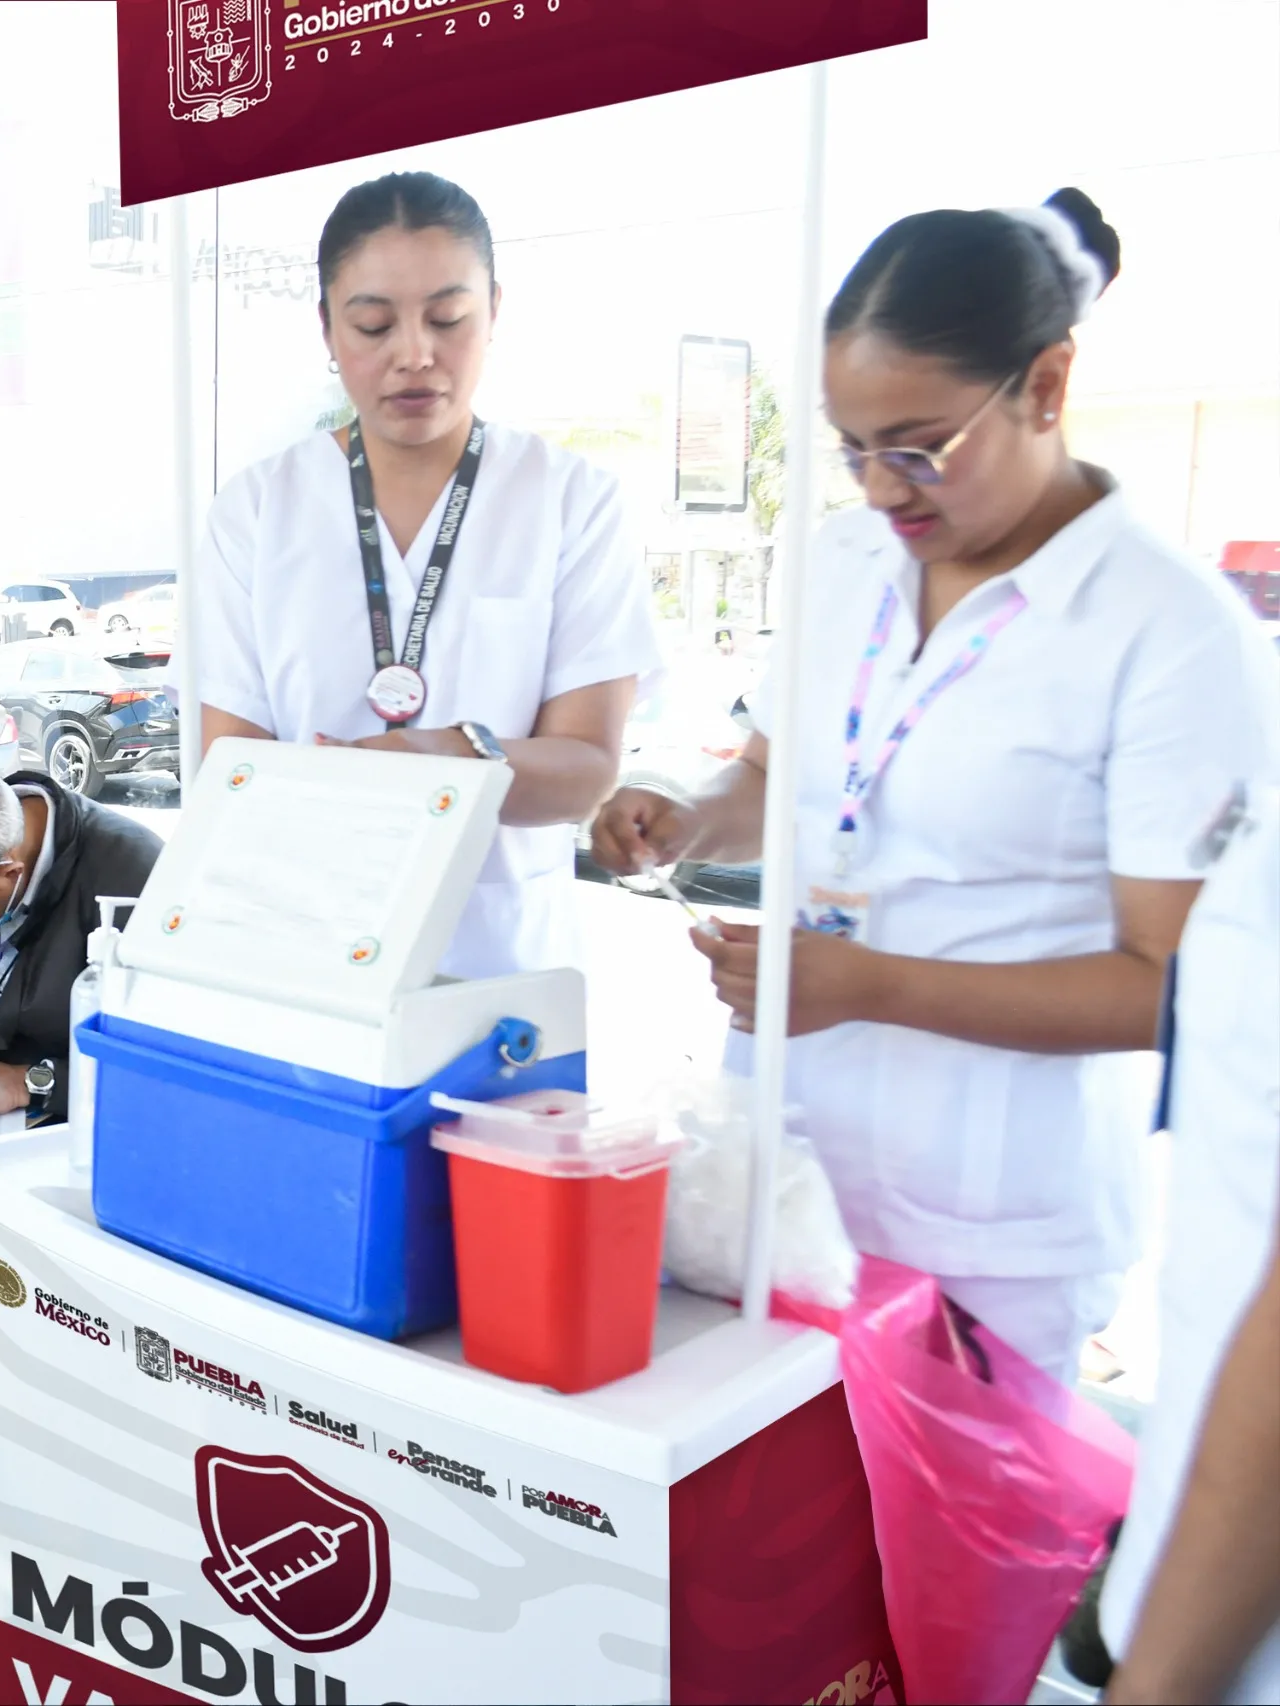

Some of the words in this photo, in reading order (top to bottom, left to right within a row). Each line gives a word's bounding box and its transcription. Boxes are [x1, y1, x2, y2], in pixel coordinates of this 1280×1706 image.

[284, 0, 409, 39] Gobierno
[423, 566, 443, 592] SALUD
[416, 598, 434, 612] DE
[35, 1287, 91, 1321] Gobierno
[94, 1317, 109, 1330] de
[35, 1296, 111, 1346] México
[174, 1348, 265, 1400] PUEBLA
[175, 1364, 216, 1388] Gobierno
[217, 1383, 233, 1395] del
[234, 1389, 267, 1407] Estado
[288, 1400, 358, 1440] Salud
[289, 1417, 329, 1436] Secretaria
[330, 1433, 341, 1441] de
[342, 1436, 365, 1449] Salud
[388, 1449, 421, 1466] en
[411, 1457, 497, 1498] Grande
[407, 1440, 486, 1478] Pensar
[522, 1484, 546, 1499] POR
[546, 1491, 602, 1519] AMOR
[601, 1512, 610, 1520] A
[522, 1493, 618, 1538] PUEBLA
